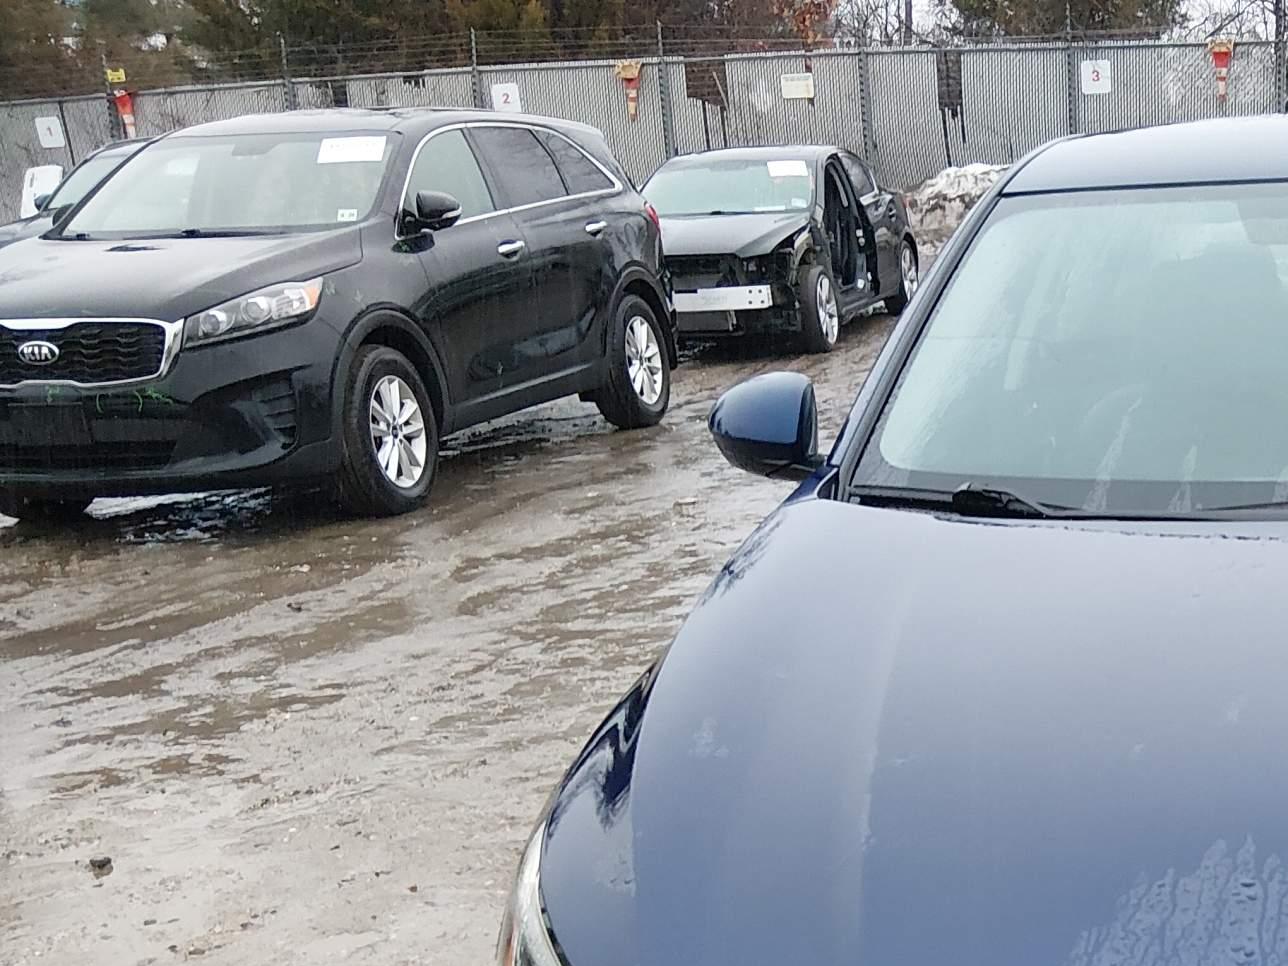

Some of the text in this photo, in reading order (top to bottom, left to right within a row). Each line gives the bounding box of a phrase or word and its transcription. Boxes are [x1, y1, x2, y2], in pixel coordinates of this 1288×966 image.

[1092, 70, 1100, 81] 3
[502, 92, 511, 104] 2
[46, 126, 53, 137] 1
[23, 346, 52, 361] KIA
